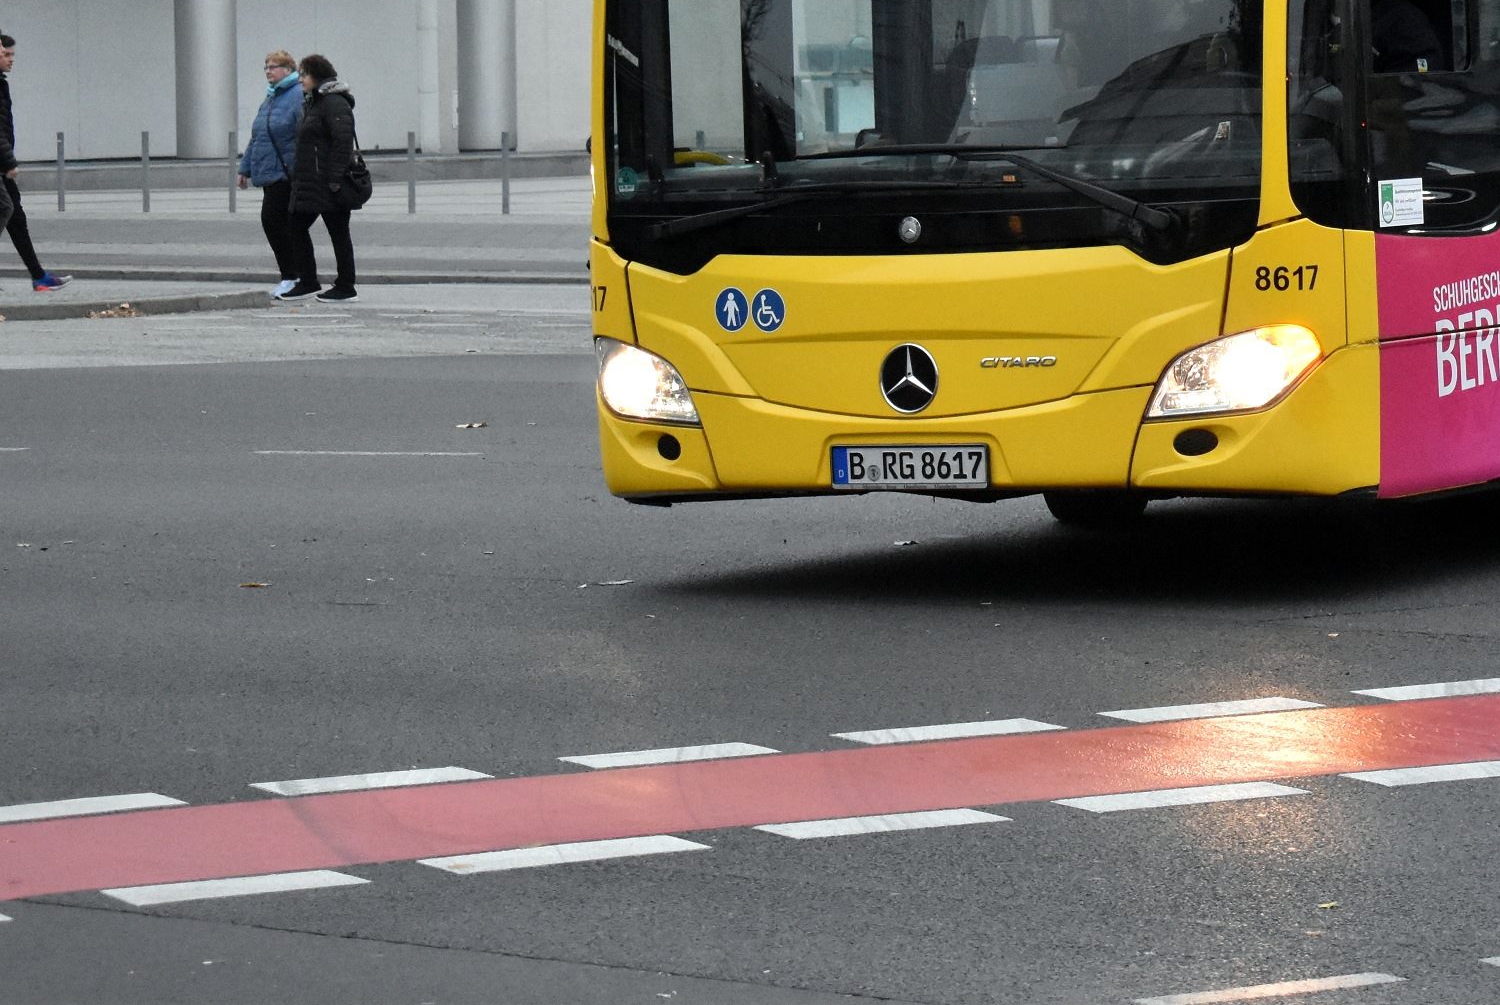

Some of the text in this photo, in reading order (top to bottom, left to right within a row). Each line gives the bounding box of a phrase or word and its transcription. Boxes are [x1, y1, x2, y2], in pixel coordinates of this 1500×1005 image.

[1254, 264, 1319, 292] 8617
[980, 355, 1058, 369] CITARO
[849, 452, 866, 480] B
[882, 451, 915, 480] RG
[921, 451, 983, 480] 8617
